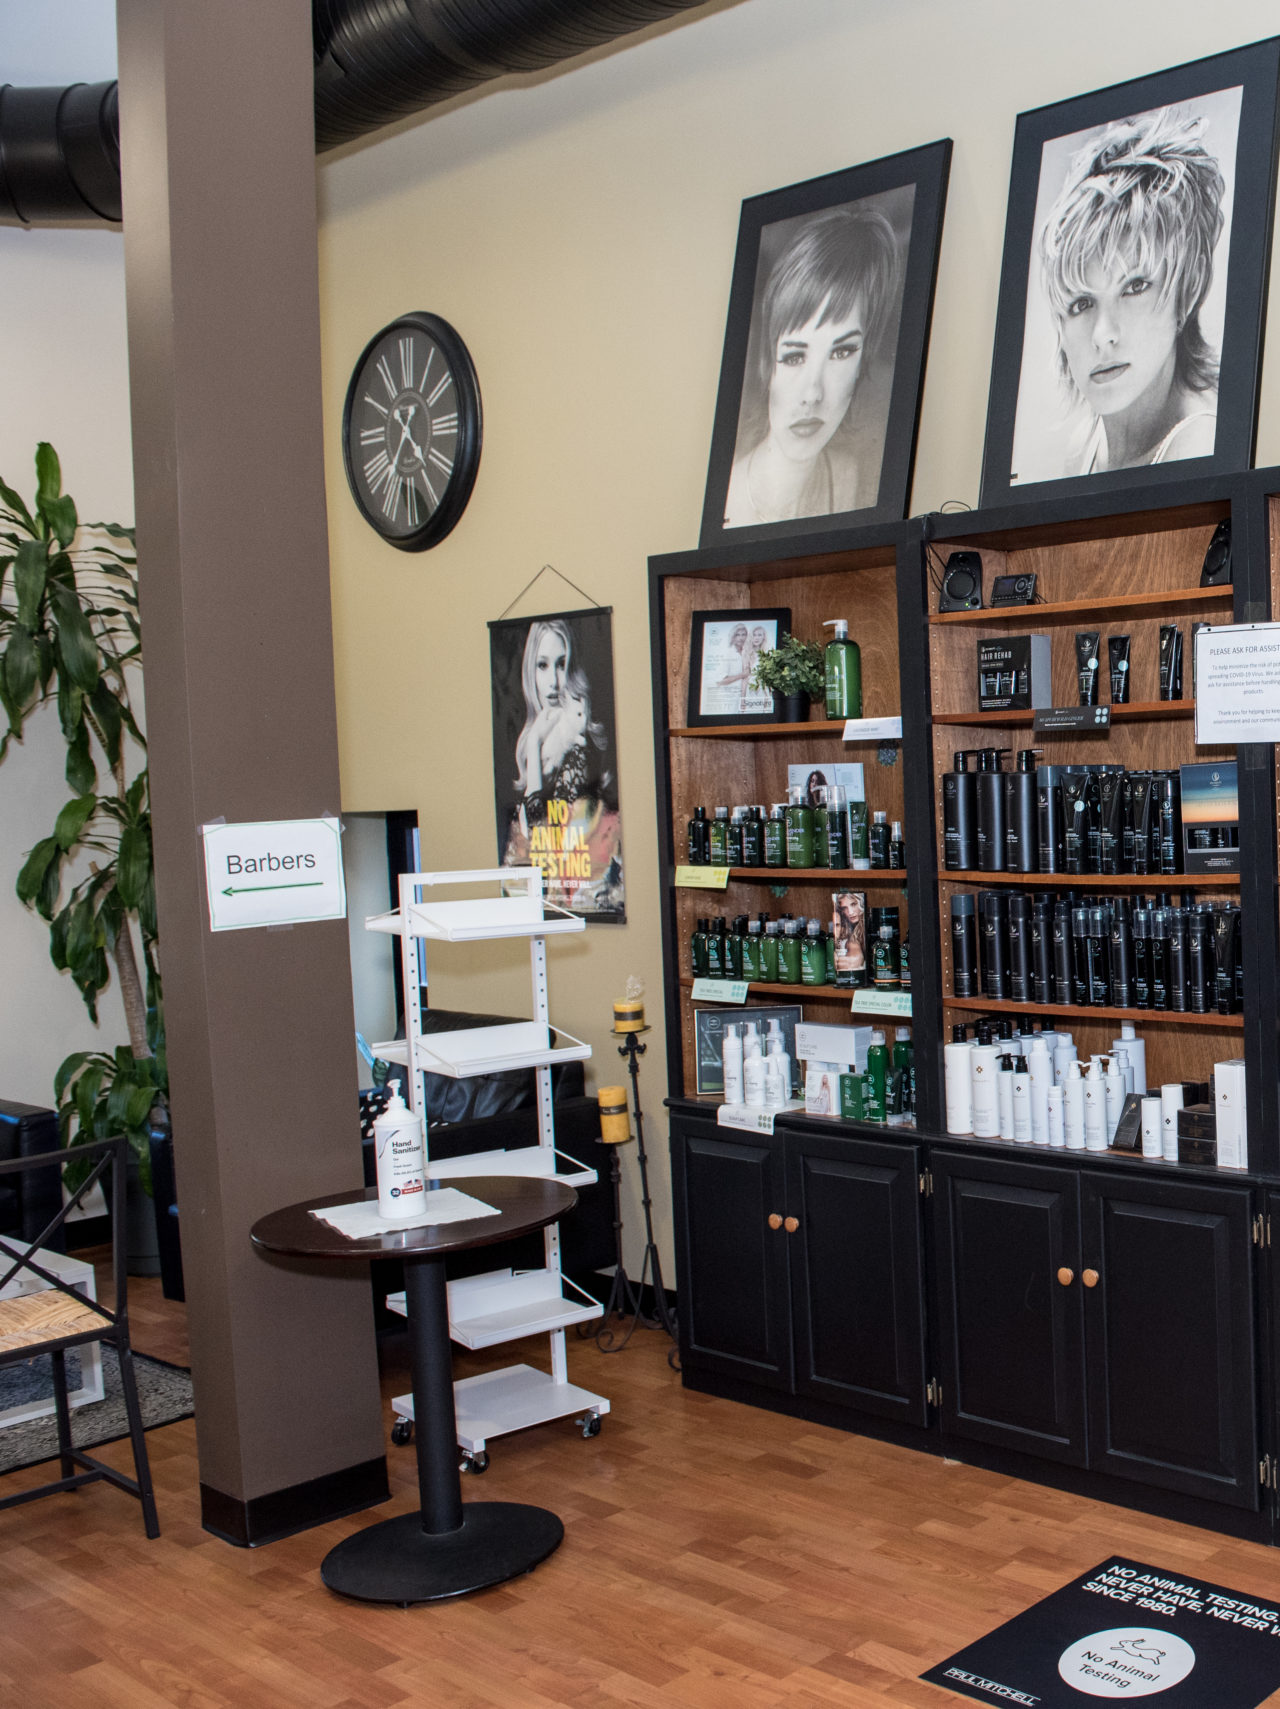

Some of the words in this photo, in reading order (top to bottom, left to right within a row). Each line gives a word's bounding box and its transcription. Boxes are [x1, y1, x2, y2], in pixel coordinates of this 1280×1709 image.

[1210, 648, 1230, 656] PLEASE
[547, 800, 568, 824] NO
[531, 826, 589, 850] ANIMAL
[226, 852, 316, 875] Barbers
[530, 852, 591, 878] TESTING
[392, 1140, 412, 1148] Hand
[392, 1146, 420, 1154] Sanitizer
[1082, 1581, 1136, 1602] SINCE
[1135, 1597, 1176, 1616] 1980.
[1094, 1573, 1154, 1596] NEVER
[1152, 1590, 1204, 1612] HAVE,
[1206, 1606, 1270, 1632] NEVER
[1107, 1565, 1137, 1578] NO
[1138, 1574, 1200, 1599] ANIMAL
[1206, 1593, 1279, 1622] TESTING.
[1078, 1664, 1132, 1688] Testing
[1082, 1650, 1104, 1664] No
[1105, 1660, 1160, 1682] Animal
[944, 1668, 978, 1685] PAUL
[976, 1677, 1037, 1706] MITCHELL
